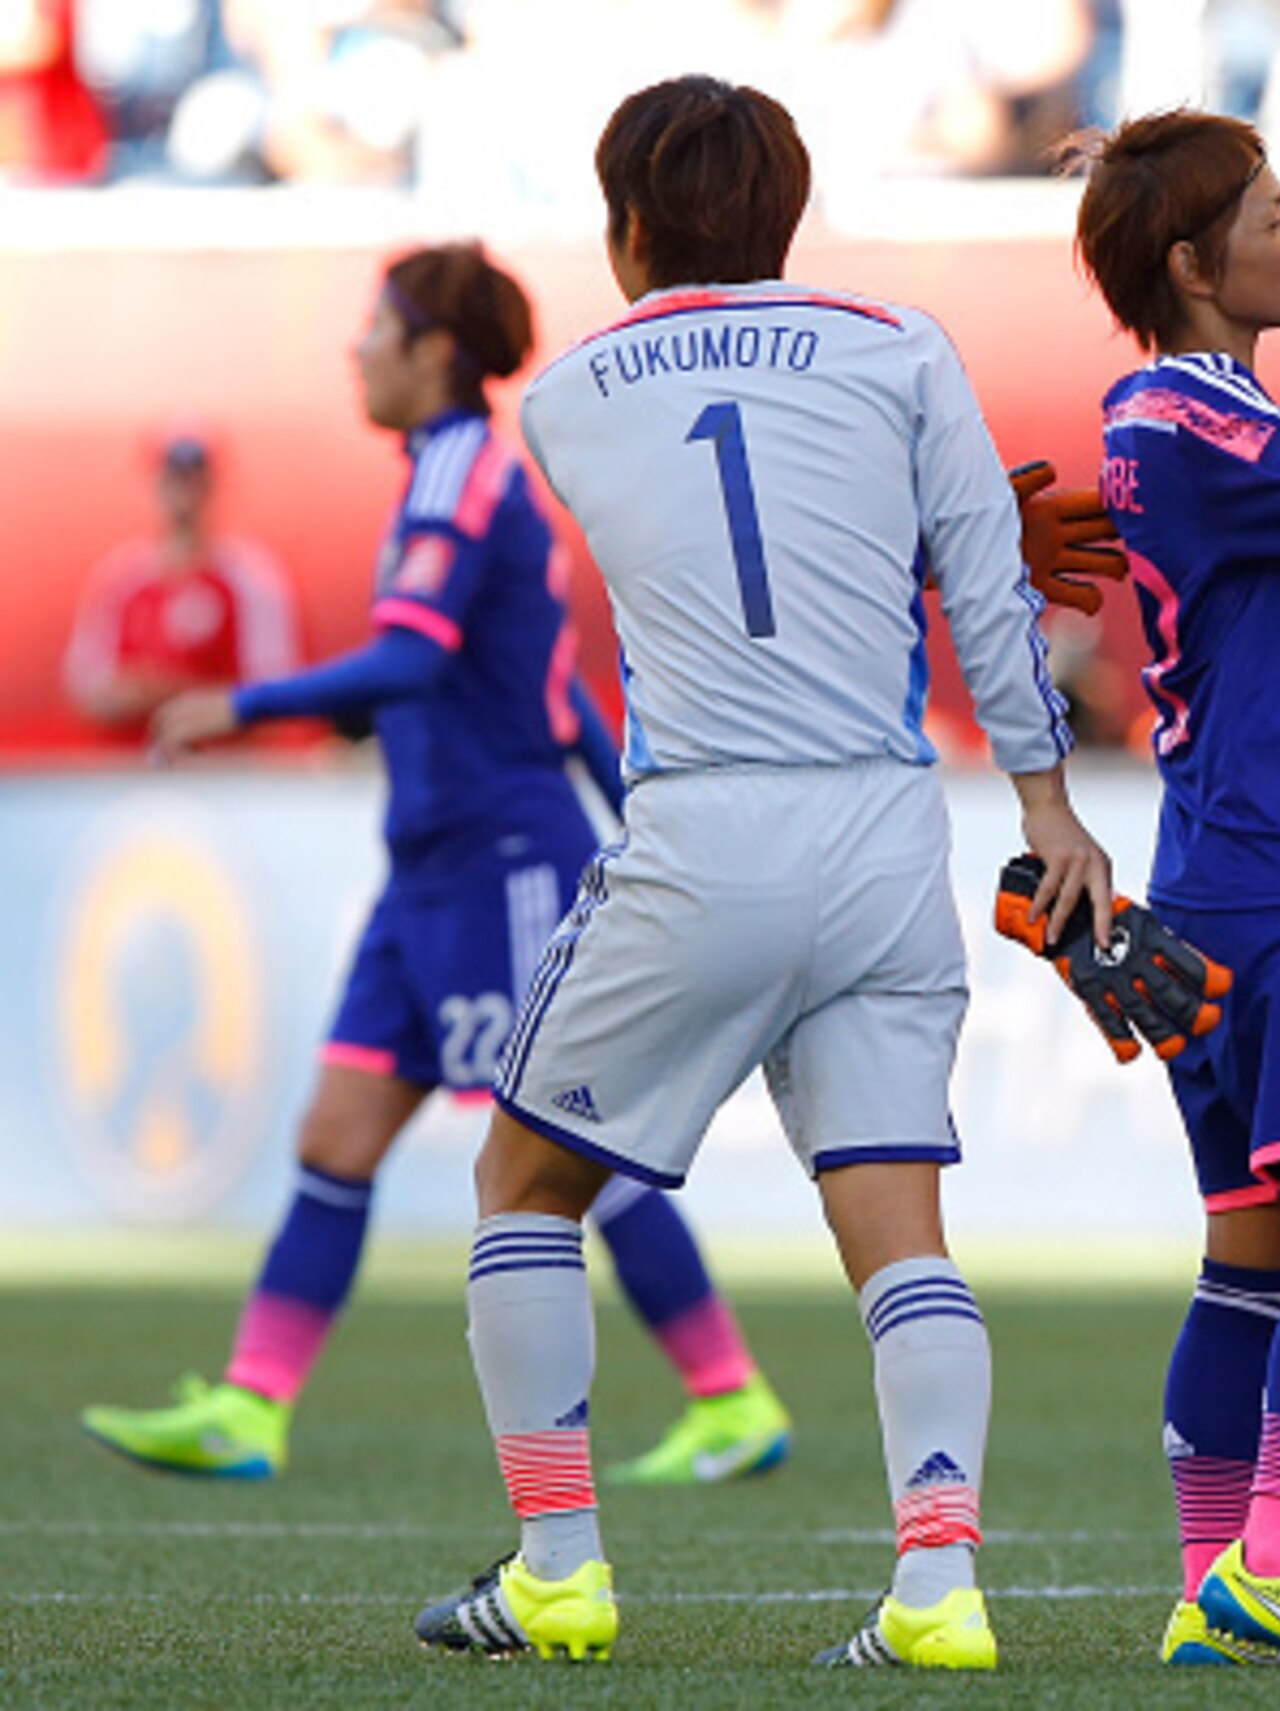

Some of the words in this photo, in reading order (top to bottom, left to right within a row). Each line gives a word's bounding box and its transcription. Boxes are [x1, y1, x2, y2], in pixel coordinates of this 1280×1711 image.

[589, 323, 819, 398] FUKUMOTO
[685, 401, 775, 637] 1
[437, 992, 513, 1085] 22
